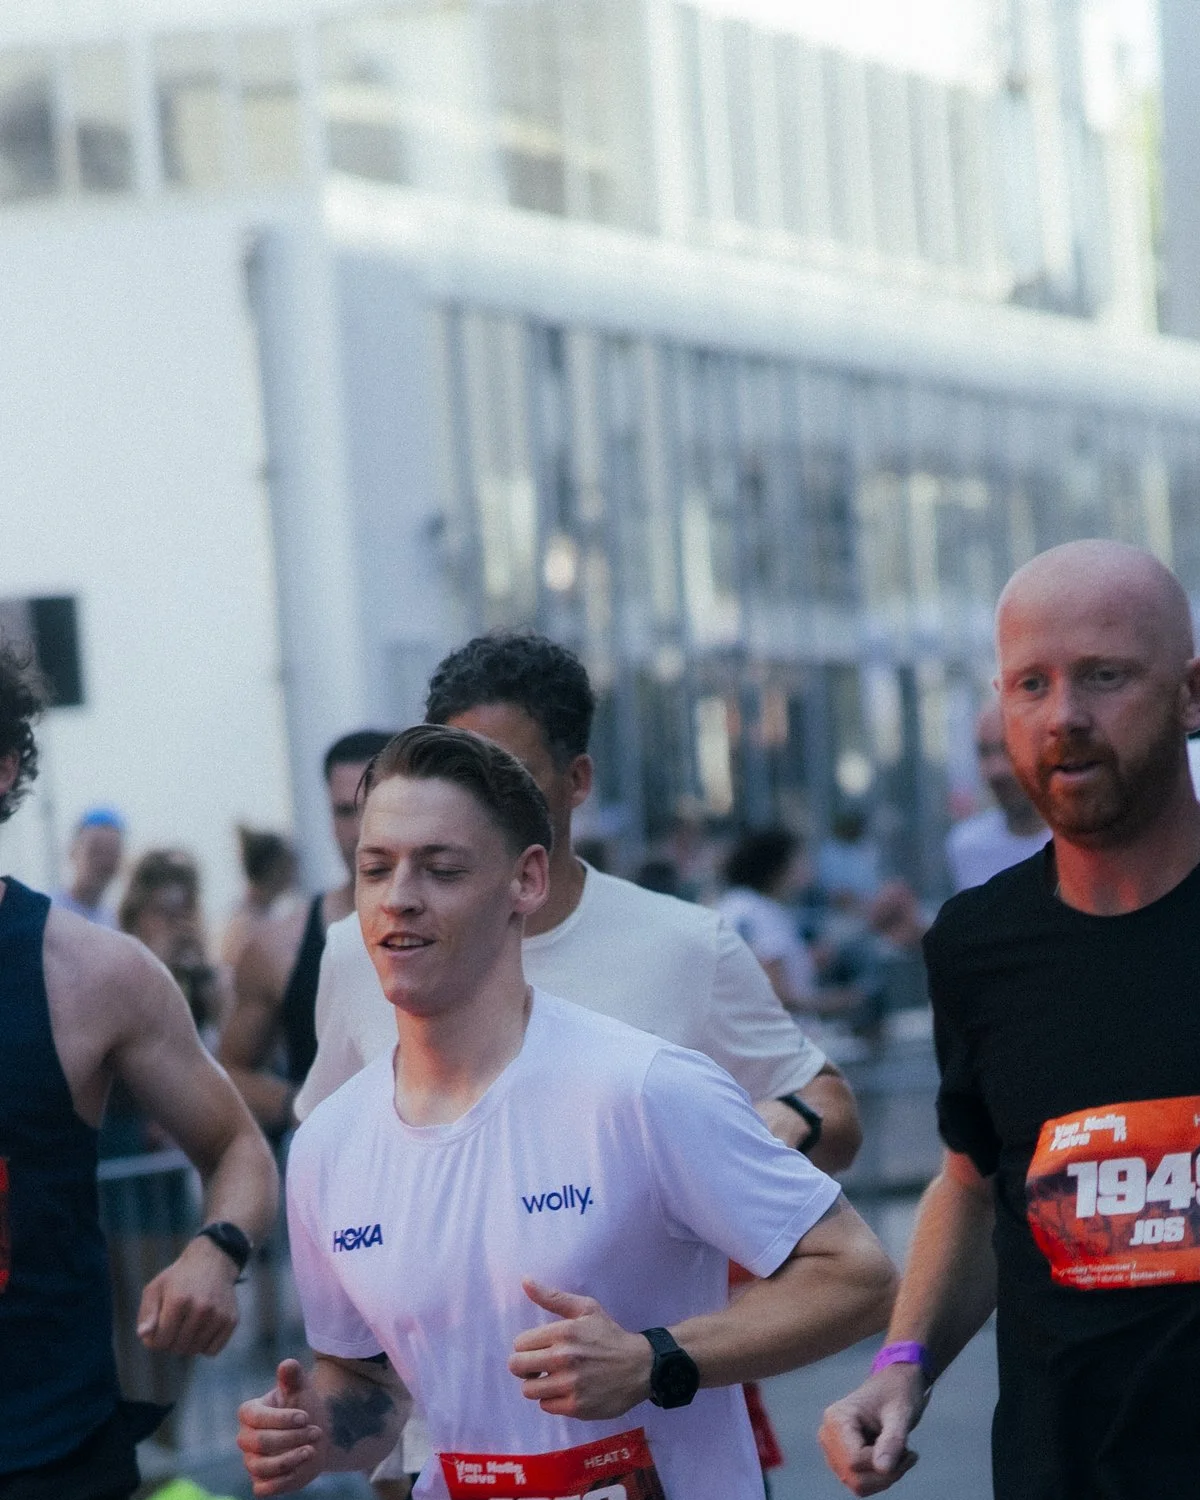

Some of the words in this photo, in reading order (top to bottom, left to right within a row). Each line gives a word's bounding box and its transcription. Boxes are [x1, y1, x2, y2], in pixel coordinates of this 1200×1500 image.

[522, 1184, 594, 1215] wolly.
[333, 1223, 384, 1253] HOKA
[1129, 1216, 1186, 1246] JOS
[584, 1450, 619, 1469] HEAT
[620, 1448, 630, 1460] 3
